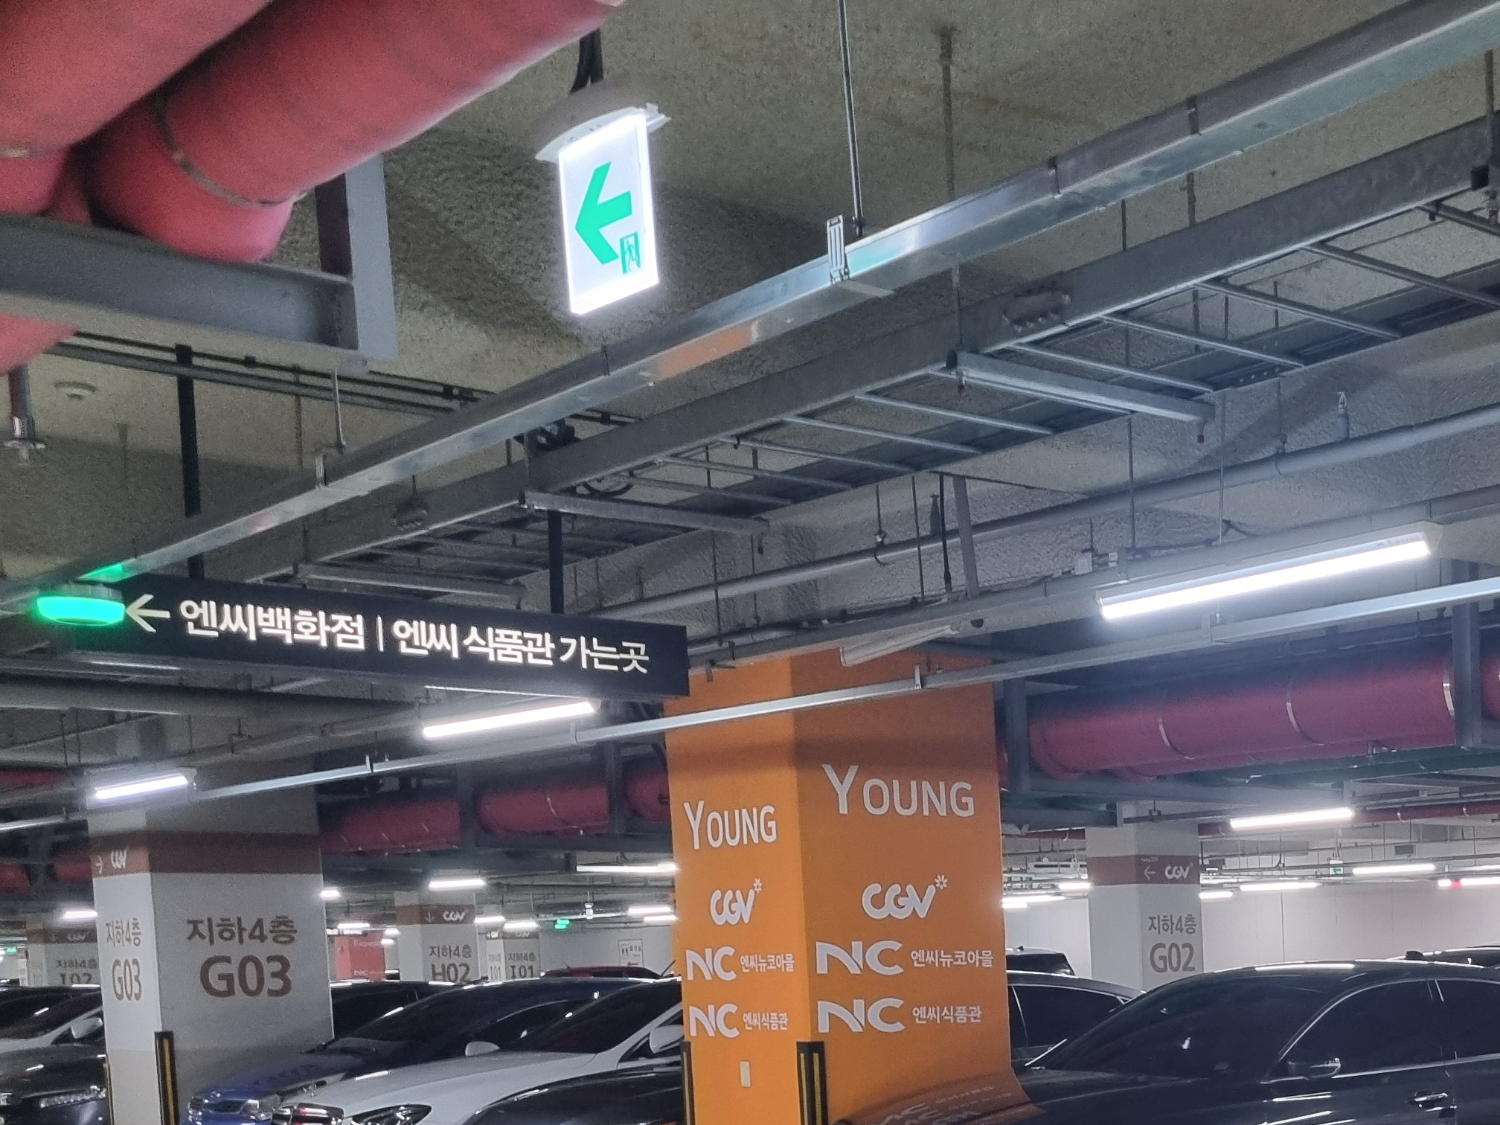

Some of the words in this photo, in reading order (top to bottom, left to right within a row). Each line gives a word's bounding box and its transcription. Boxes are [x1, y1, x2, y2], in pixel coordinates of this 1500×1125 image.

[179, 599, 366, 651] 엔씨백화점
[391, 619, 459, 659] 엔씨
[463, 625, 554, 666] 식품관
[559, 636, 650, 675] 가는곳
[821, 763, 975, 818] YOUNG
[683, 800, 777, 850] YOUNG
[1164, 865, 1190, 880] CGV
[710, 888, 755, 926] CGV
[861, 882, 936, 920] CGV
[105, 917, 142, 948] 지하4층
[185, 914, 298, 948] 지하4층
[1148, 914, 1197, 935] 지하4층
[199, 954, 293, 998] G03
[431, 962, 471, 984] H02
[685, 946, 737, 982] NC
[740, 952, 795, 973] 엔씨뉴코아몰
[815, 940, 904, 976] NC
[910, 949, 994, 969] 엔씨뉴코아몰
[1149, 942, 1196, 974] G02
[112, 958, 143, 1002] G03
[688, 1003, 740, 1039] NC
[742, 1011, 789, 1031] 엔씨식품관
[817, 997, 905, 1034] NC
[912, 1005, 982, 1024] 엔씨식품관
